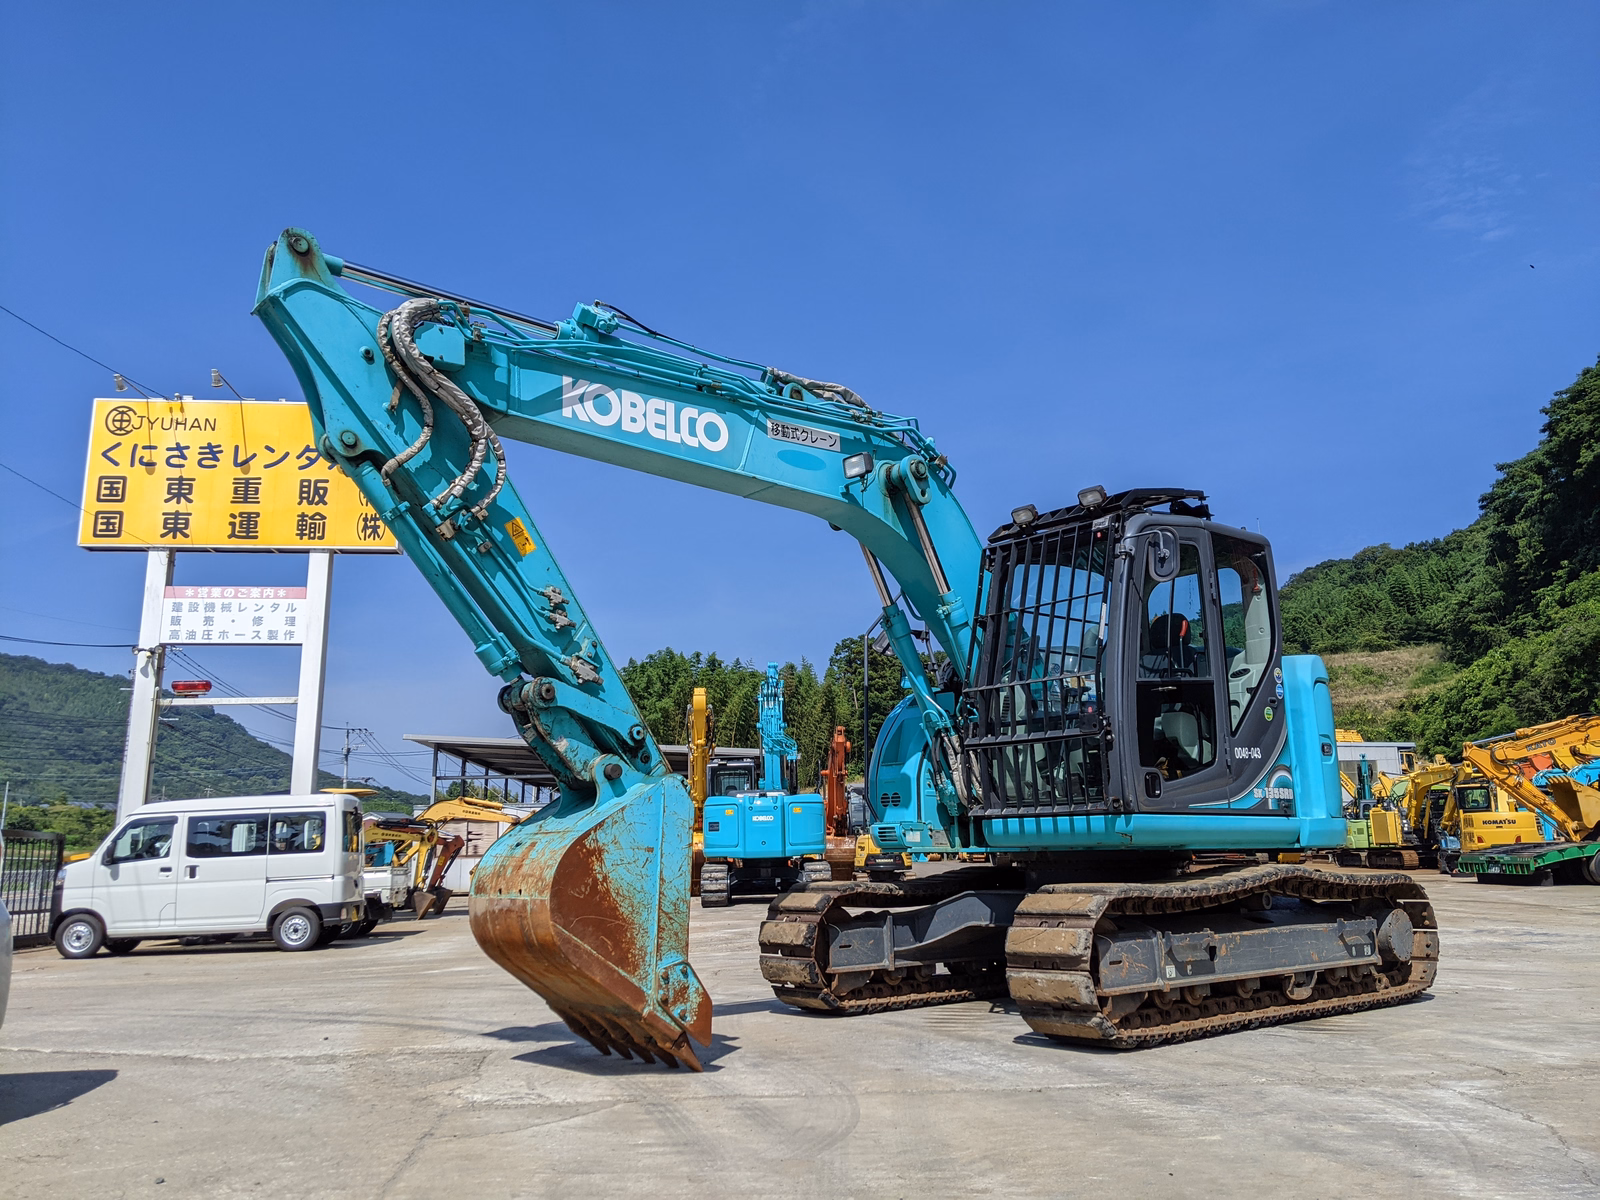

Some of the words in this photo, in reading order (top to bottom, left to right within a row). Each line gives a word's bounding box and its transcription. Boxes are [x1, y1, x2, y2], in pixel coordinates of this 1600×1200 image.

[562, 375, 729, 452] KOBELCO
[132, 415, 217, 432] JYUHAN
[771, 422, 837, 447] 移動式クレーン
[101, 442, 337, 470] くにさきレンタ
[171, 601, 298, 613] 建設機械レンタル
[168, 629, 296, 641] 高油圧ホース製作
[1525, 737, 1557, 752] KATO
